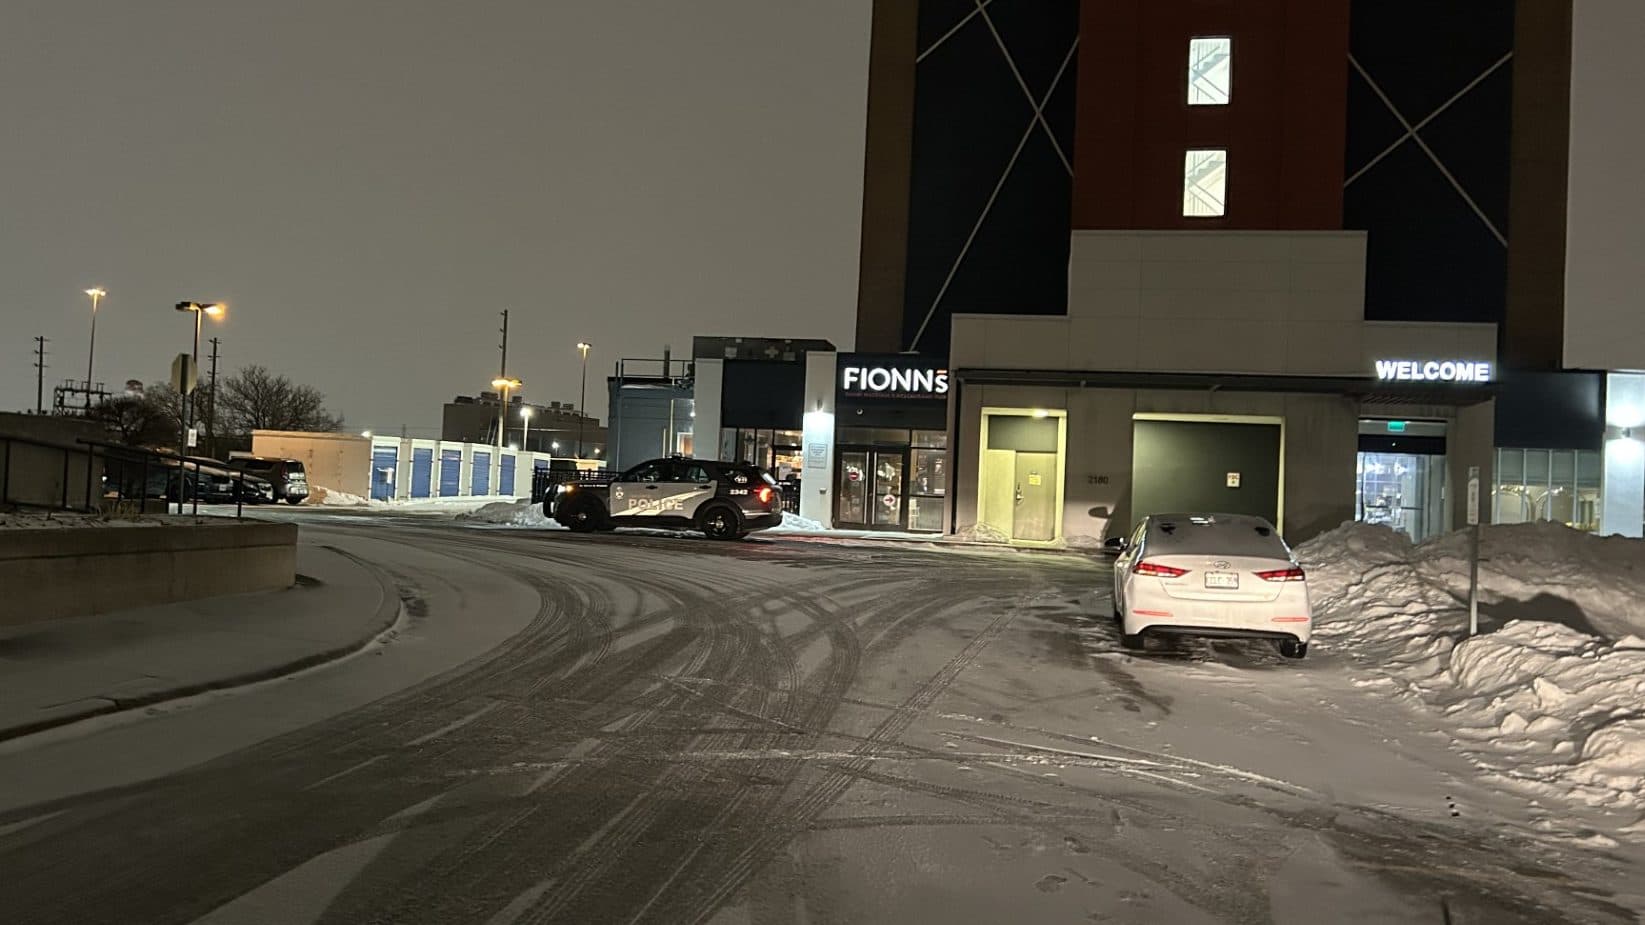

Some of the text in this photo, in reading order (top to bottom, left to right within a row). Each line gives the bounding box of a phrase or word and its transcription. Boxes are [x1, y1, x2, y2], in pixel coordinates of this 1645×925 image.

[1375, 360, 1489, 381] WELCOME
[1088, 475, 1109, 485] 2180
[628, 498, 684, 511] POLICE
